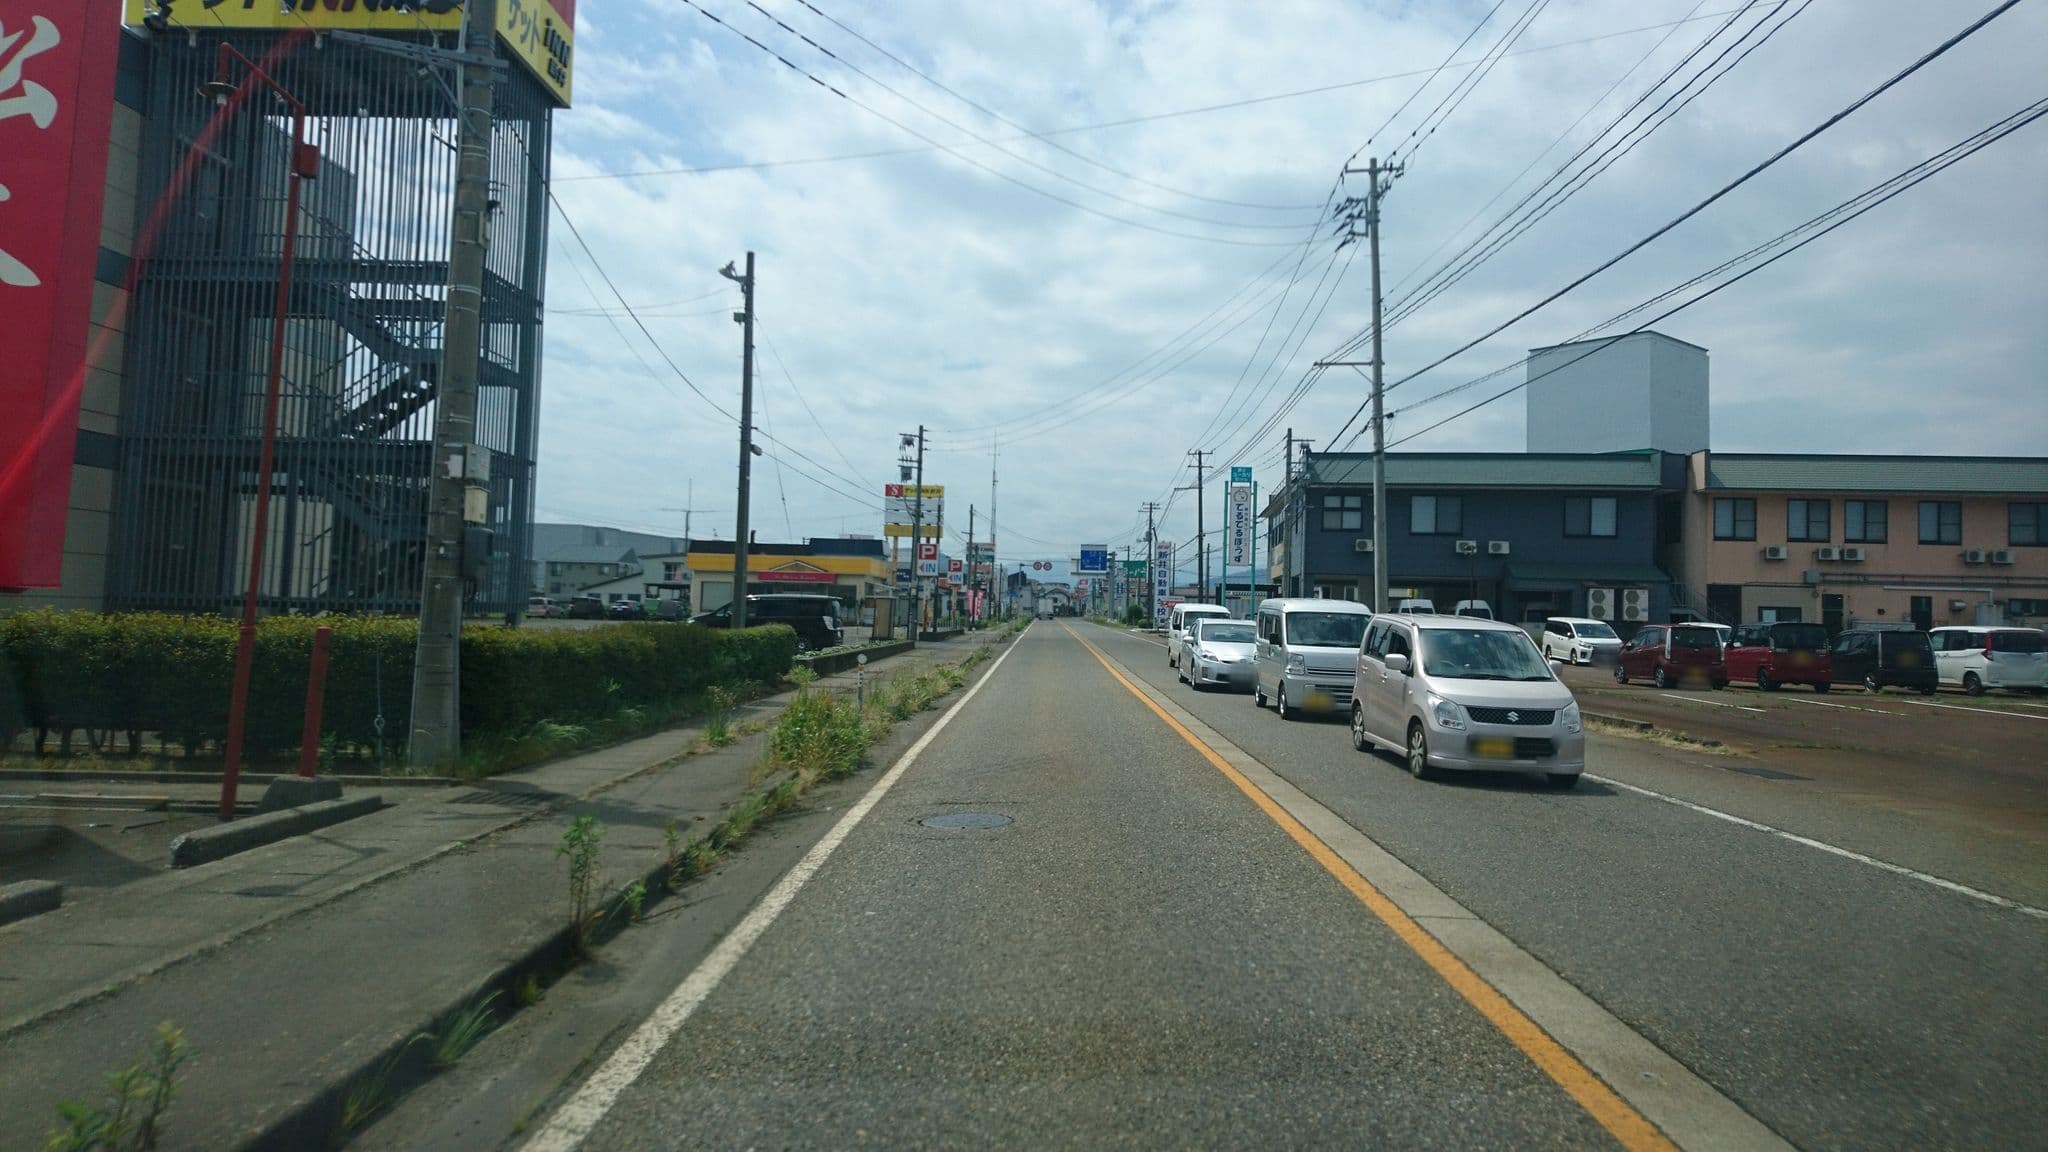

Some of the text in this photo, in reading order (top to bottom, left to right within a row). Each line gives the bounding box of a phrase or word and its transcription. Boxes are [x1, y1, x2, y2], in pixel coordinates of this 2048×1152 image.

[922, 545, 936, 558] P
[925, 563, 936, 573] IN
[950, 561, 961, 571] P
[953, 574, 962, 582] IN
